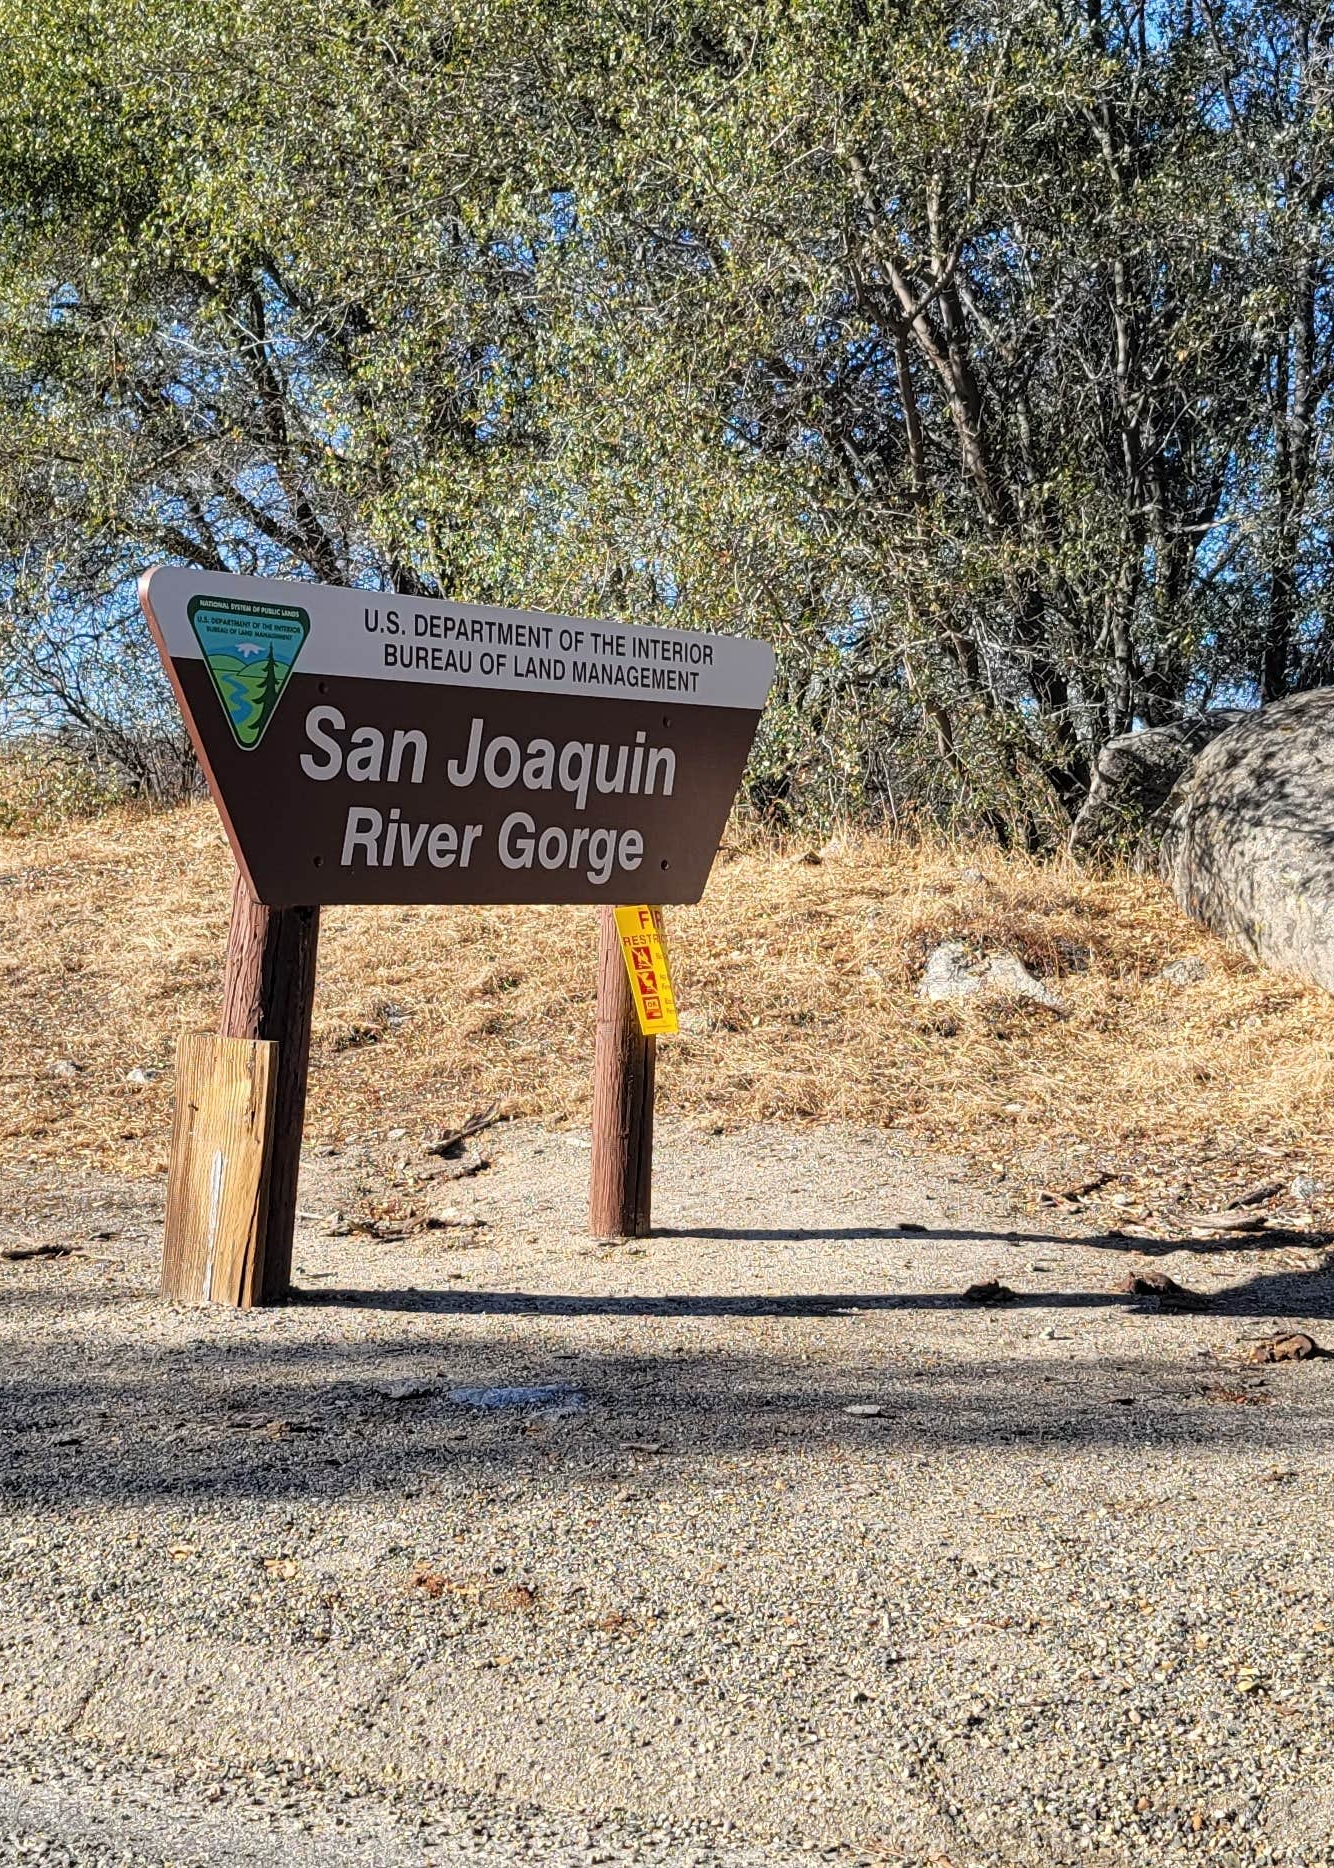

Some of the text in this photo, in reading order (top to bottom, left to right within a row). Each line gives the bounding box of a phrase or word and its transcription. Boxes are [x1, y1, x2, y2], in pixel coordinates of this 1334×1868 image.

[197, 615, 300, 633] U.S. DEPARTMENT OF THE INTERIOR
[199, 600, 229, 609] NATIONAL
[230, 603, 251, 613] SYSTEM
[261, 605, 280, 616] PUBLIC
[281, 609, 299, 618] LANDS
[206, 626, 228, 634] BUREAU
[238, 629, 253, 637] LAND
[364, 608, 714, 667] U.S. DEPARTMENT OF THE INTERIOR
[384, 643, 701, 693] BUREAU OF LAND MANAGEMENT
[299, 705, 676, 810] San Joaquin
[340, 806, 644, 885] River Gorge
